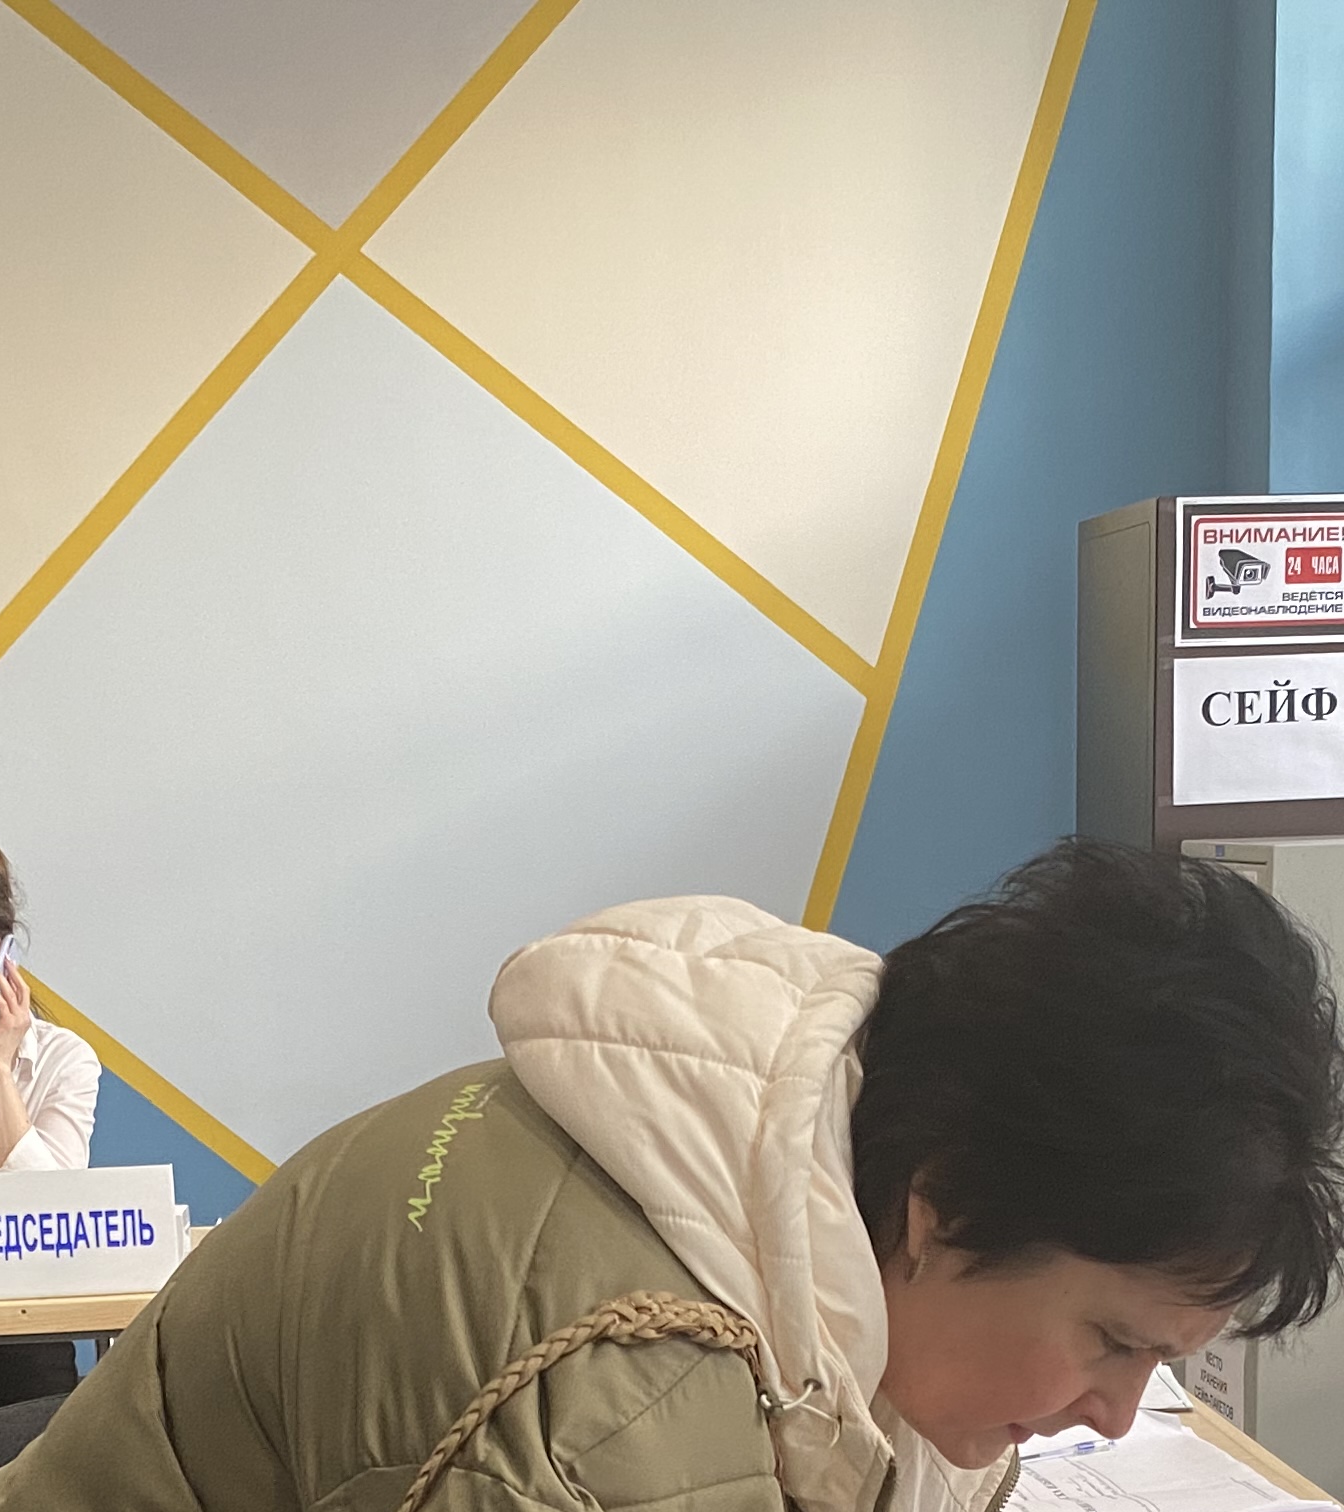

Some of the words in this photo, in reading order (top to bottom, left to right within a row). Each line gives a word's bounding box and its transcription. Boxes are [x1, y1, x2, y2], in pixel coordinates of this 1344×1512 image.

[1287, 556, 1302, 576] 24
[1311, 553, 1340, 575] ЧАСА
[1202, 603, 1344, 618] ВИДЕОНАБЛЮДЕНИЕ
[1201, 678, 1339, 727] СЕЙФ
